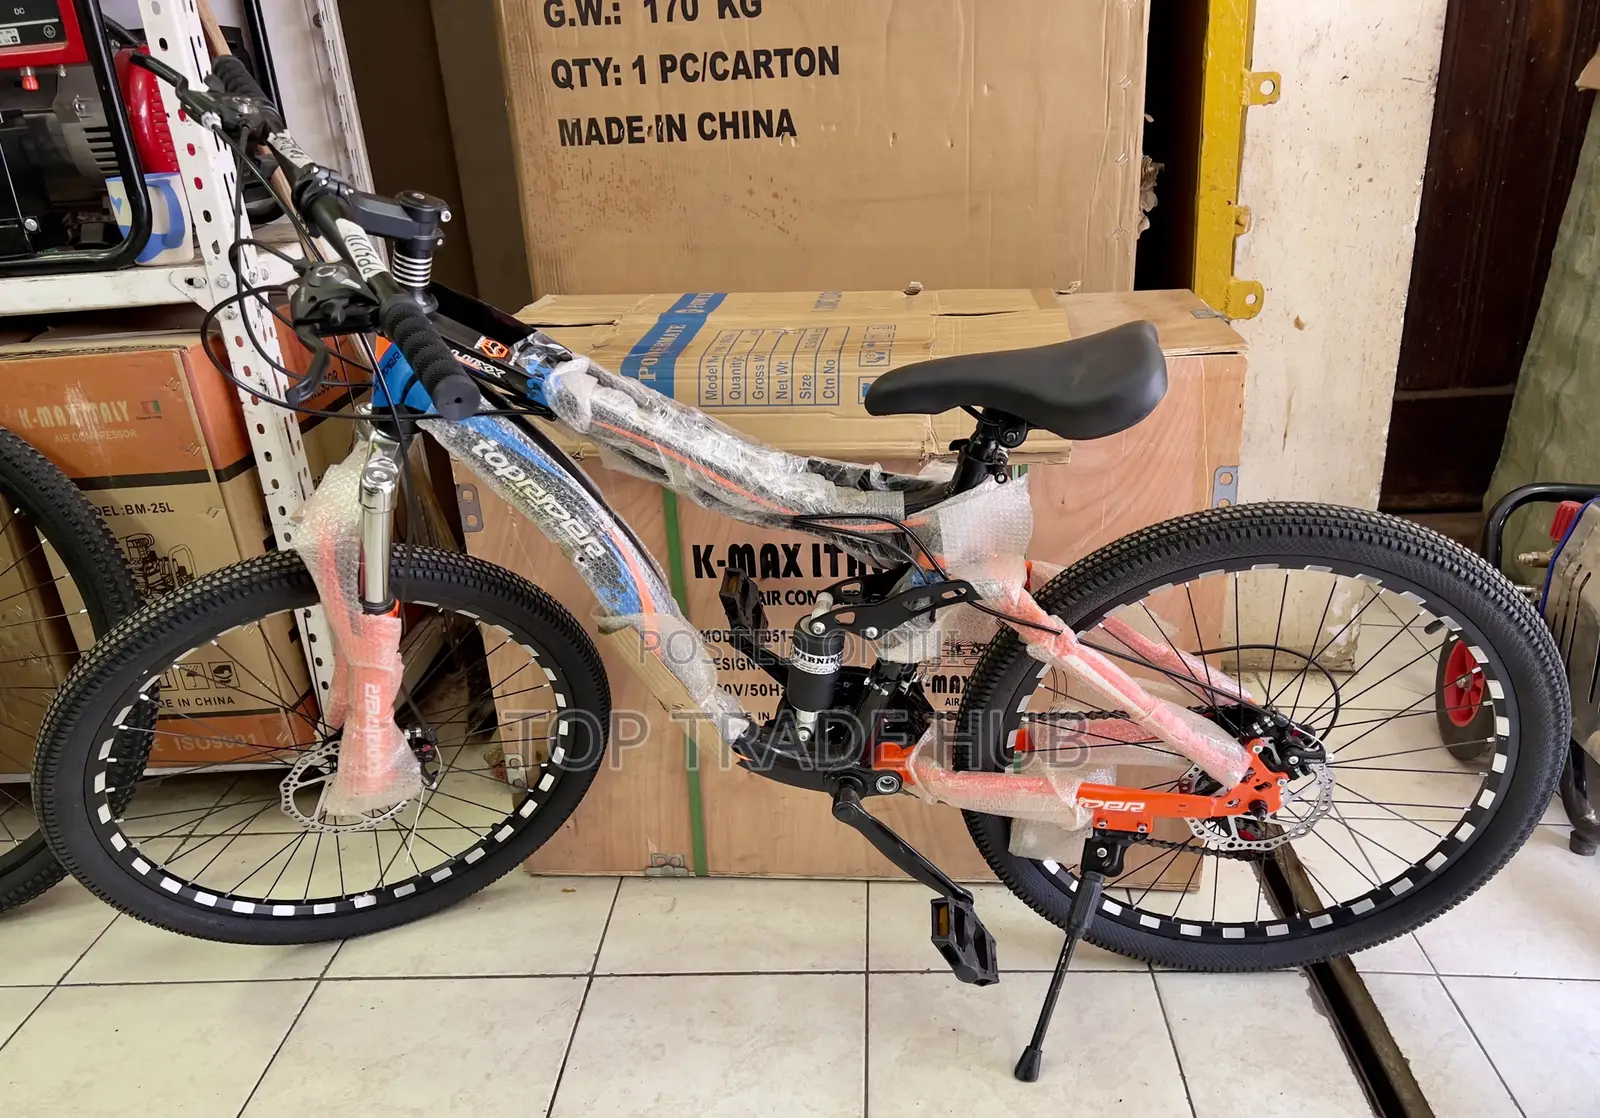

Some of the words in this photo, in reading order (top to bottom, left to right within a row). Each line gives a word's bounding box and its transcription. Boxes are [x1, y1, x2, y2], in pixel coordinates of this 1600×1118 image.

[13, 7, 26, 16] DC
[544, 0, 622, 28] G.W.:
[643, 0, 699, 24] 170
[717, 0, 762, 20] KG
[551, 57, 623, 91] QTY:
[631, 54, 647, 85] 1
[659, 45, 840, 84] PC/CARTON
[557, 115, 646, 147] MADE
[655, 113, 688, 143] IN
[697, 108, 798, 142] CHINA
[638, 324, 687, 382] POWERMATE
[776, 361, 789, 376] Wt
[823, 359, 836, 375] No
[705, 364, 719, 400] Model
[752, 364, 765, 400] Gross
[776, 379, 788, 400] Net
[799, 374, 812, 400] Size
[823, 378, 836, 399] Ctn
[692, 543, 804, 579] K-MAX
[177, 698, 191, 707] IN
[194, 696, 235, 706] CHINA
